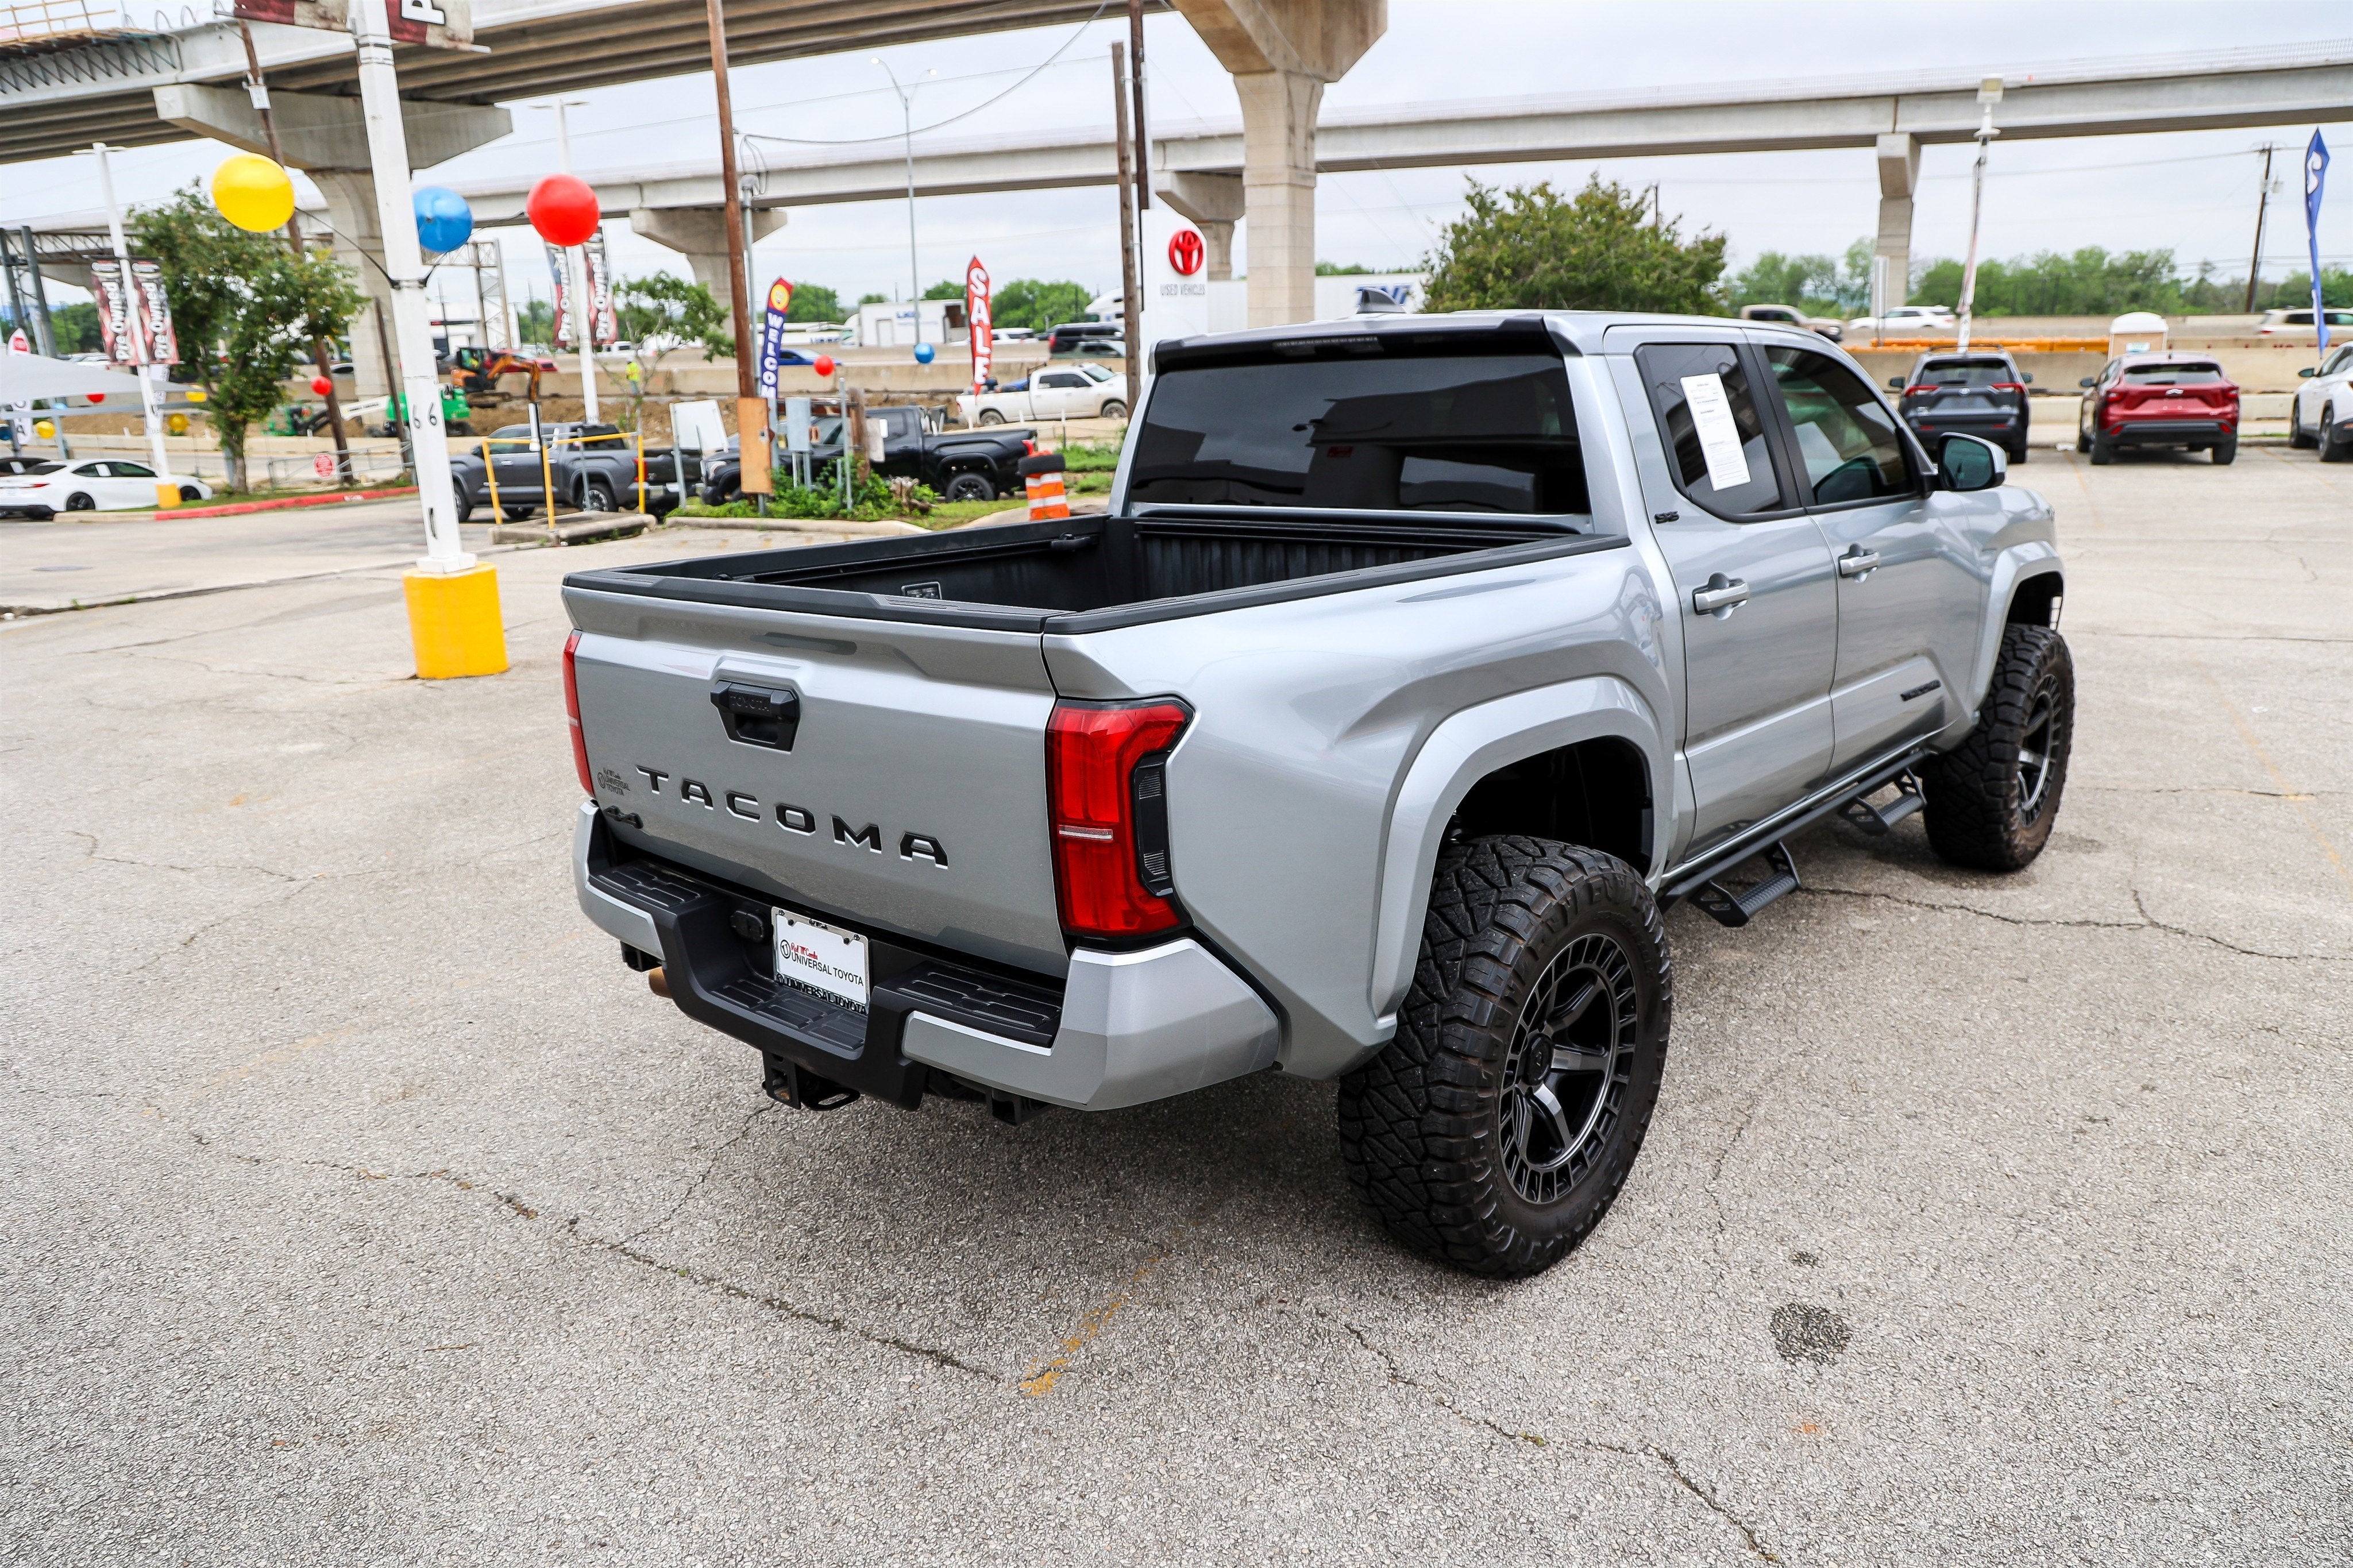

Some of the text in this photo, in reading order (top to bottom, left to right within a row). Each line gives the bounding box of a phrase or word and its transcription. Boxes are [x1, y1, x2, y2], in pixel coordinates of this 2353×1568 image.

[101, 281, 126, 334] Owned
[141, 282, 165, 333] Owned
[970, 267, 992, 384] SALE
[761, 312, 784, 399] WELCOM
[730, 695, 770, 712] TOYOTA
[604, 774, 630, 791] UNIVERSAL
[607, 783, 624, 797] TOYOTA
[635, 764, 949, 870] TACOMA
[791, 943, 799, 953] Red
[791, 952, 864, 986] UNIVERSAL TOYOTA
[785, 978, 834, 1002] UNIVERSAL
[834, 994, 867, 1015] TOYOTA
